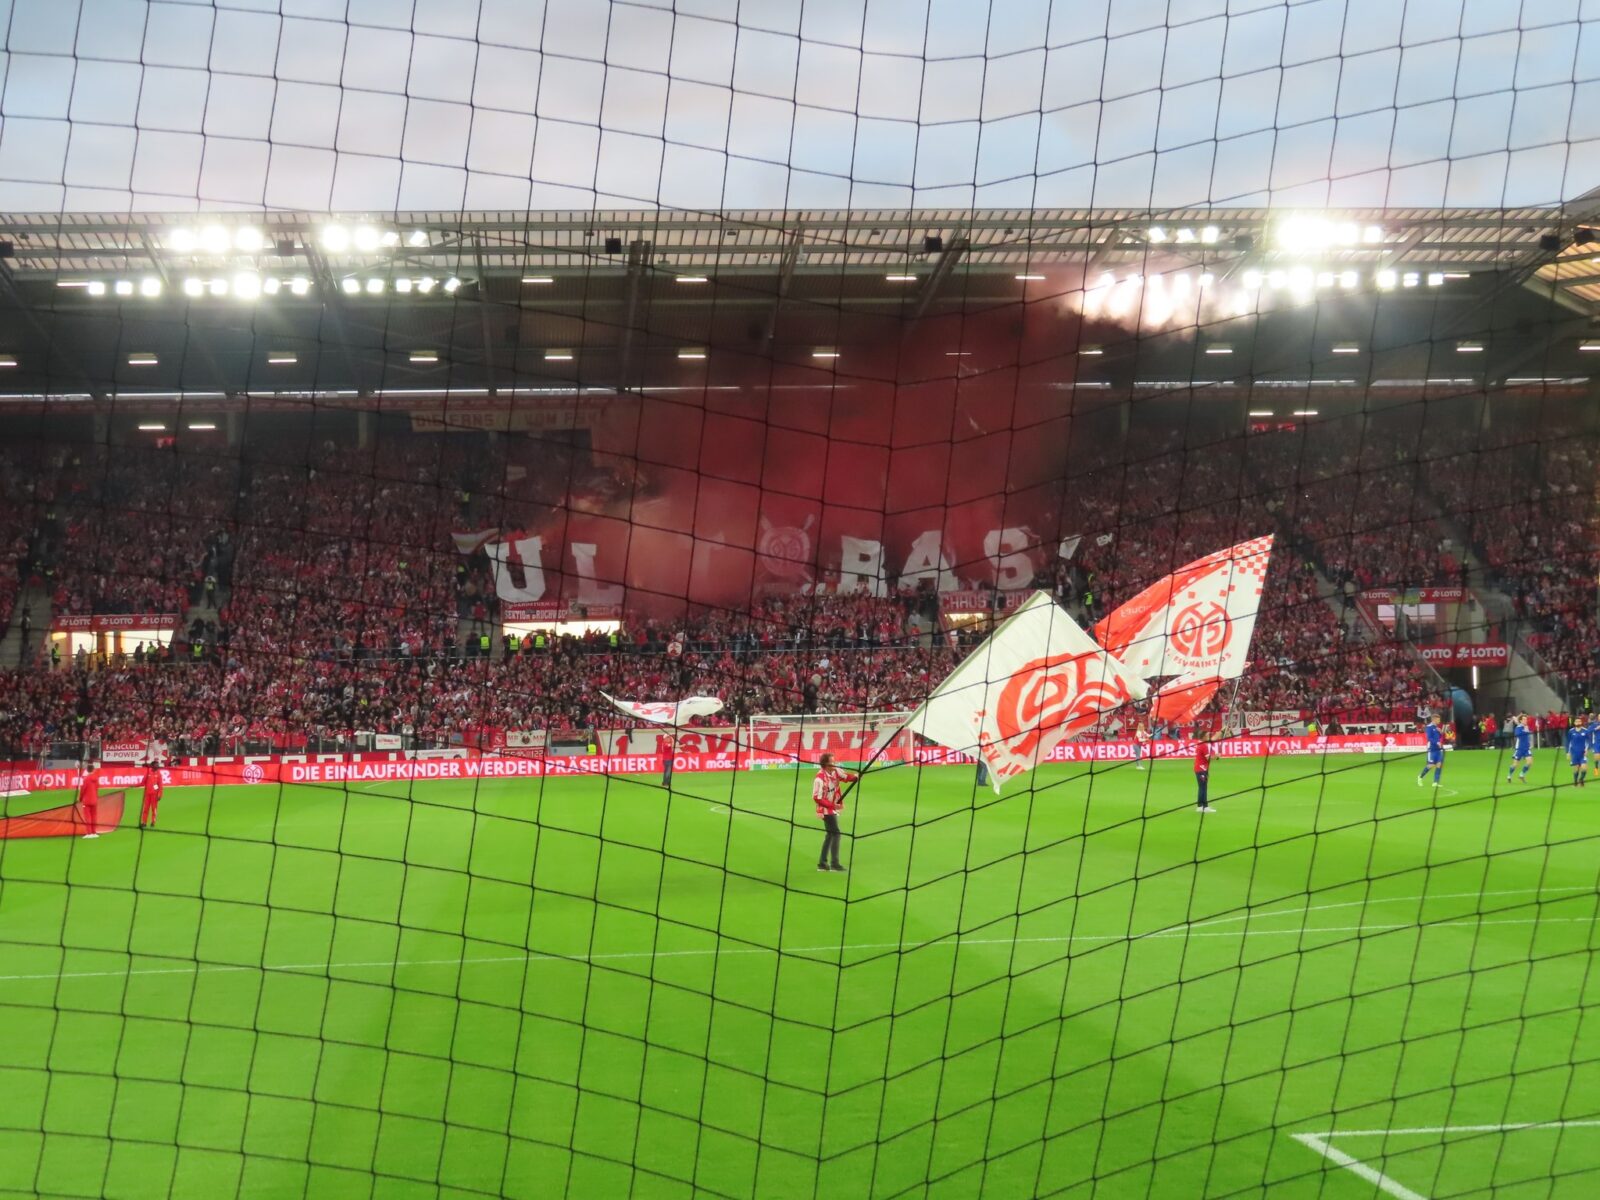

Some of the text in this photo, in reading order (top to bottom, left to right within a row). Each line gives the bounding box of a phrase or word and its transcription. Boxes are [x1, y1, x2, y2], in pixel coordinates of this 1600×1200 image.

[1440, 590, 1462, 598] LOTTO
[109, 617, 134, 625] LOTTO
[150, 616, 174, 624] LOTTO
[1471, 647, 1506, 658] LOTTO
[105, 743, 140, 751] FANCLUB
[746, 730, 880, 753] MAINZ
[915, 749, 942, 763] DIE
[1155, 739, 1262, 757] PRÄSNTIERT
[1265, 740, 1302, 755] VON
[292, 766, 320, 781] DIE
[325, 761, 460, 780] EINLAUFKINDER
[465, 758, 541, 776] WERDEN
[544, 756, 658, 774] PRÄSENTIERT
[34, 772, 66, 788] VON
